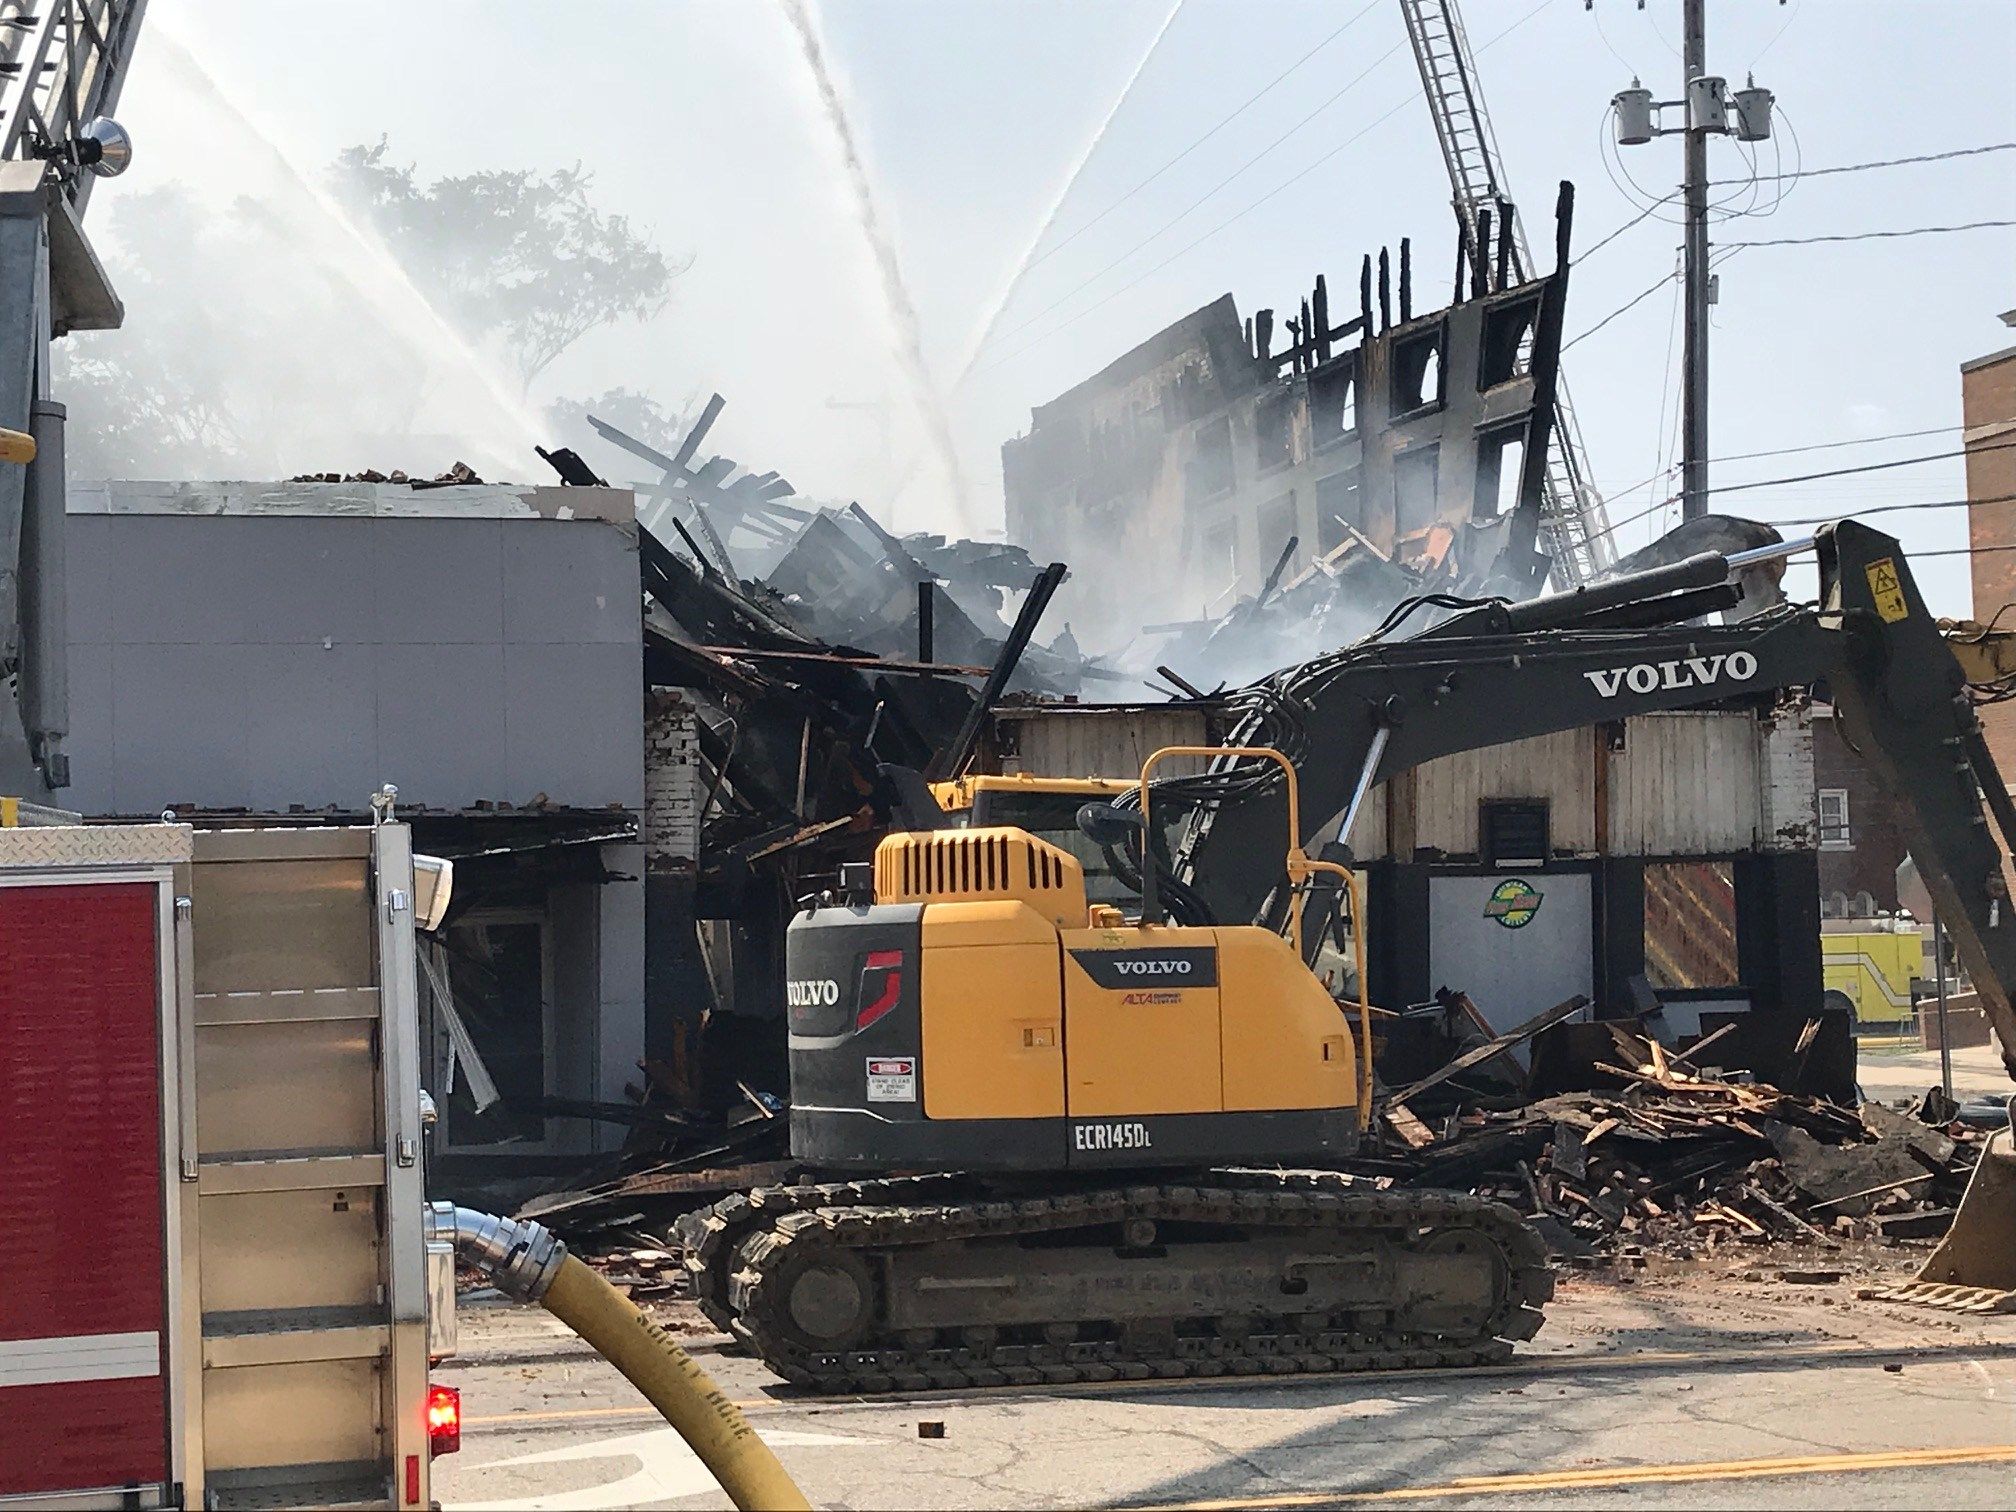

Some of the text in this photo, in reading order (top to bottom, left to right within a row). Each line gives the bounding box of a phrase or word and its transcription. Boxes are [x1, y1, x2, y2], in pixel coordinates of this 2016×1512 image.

[1583, 651, 1758, 698] VOLVO
[1113, 960, 1192, 975] VOLVO
[1122, 993, 1154, 1005] ALTA
[1075, 1123, 1152, 1150] ECR145DL
